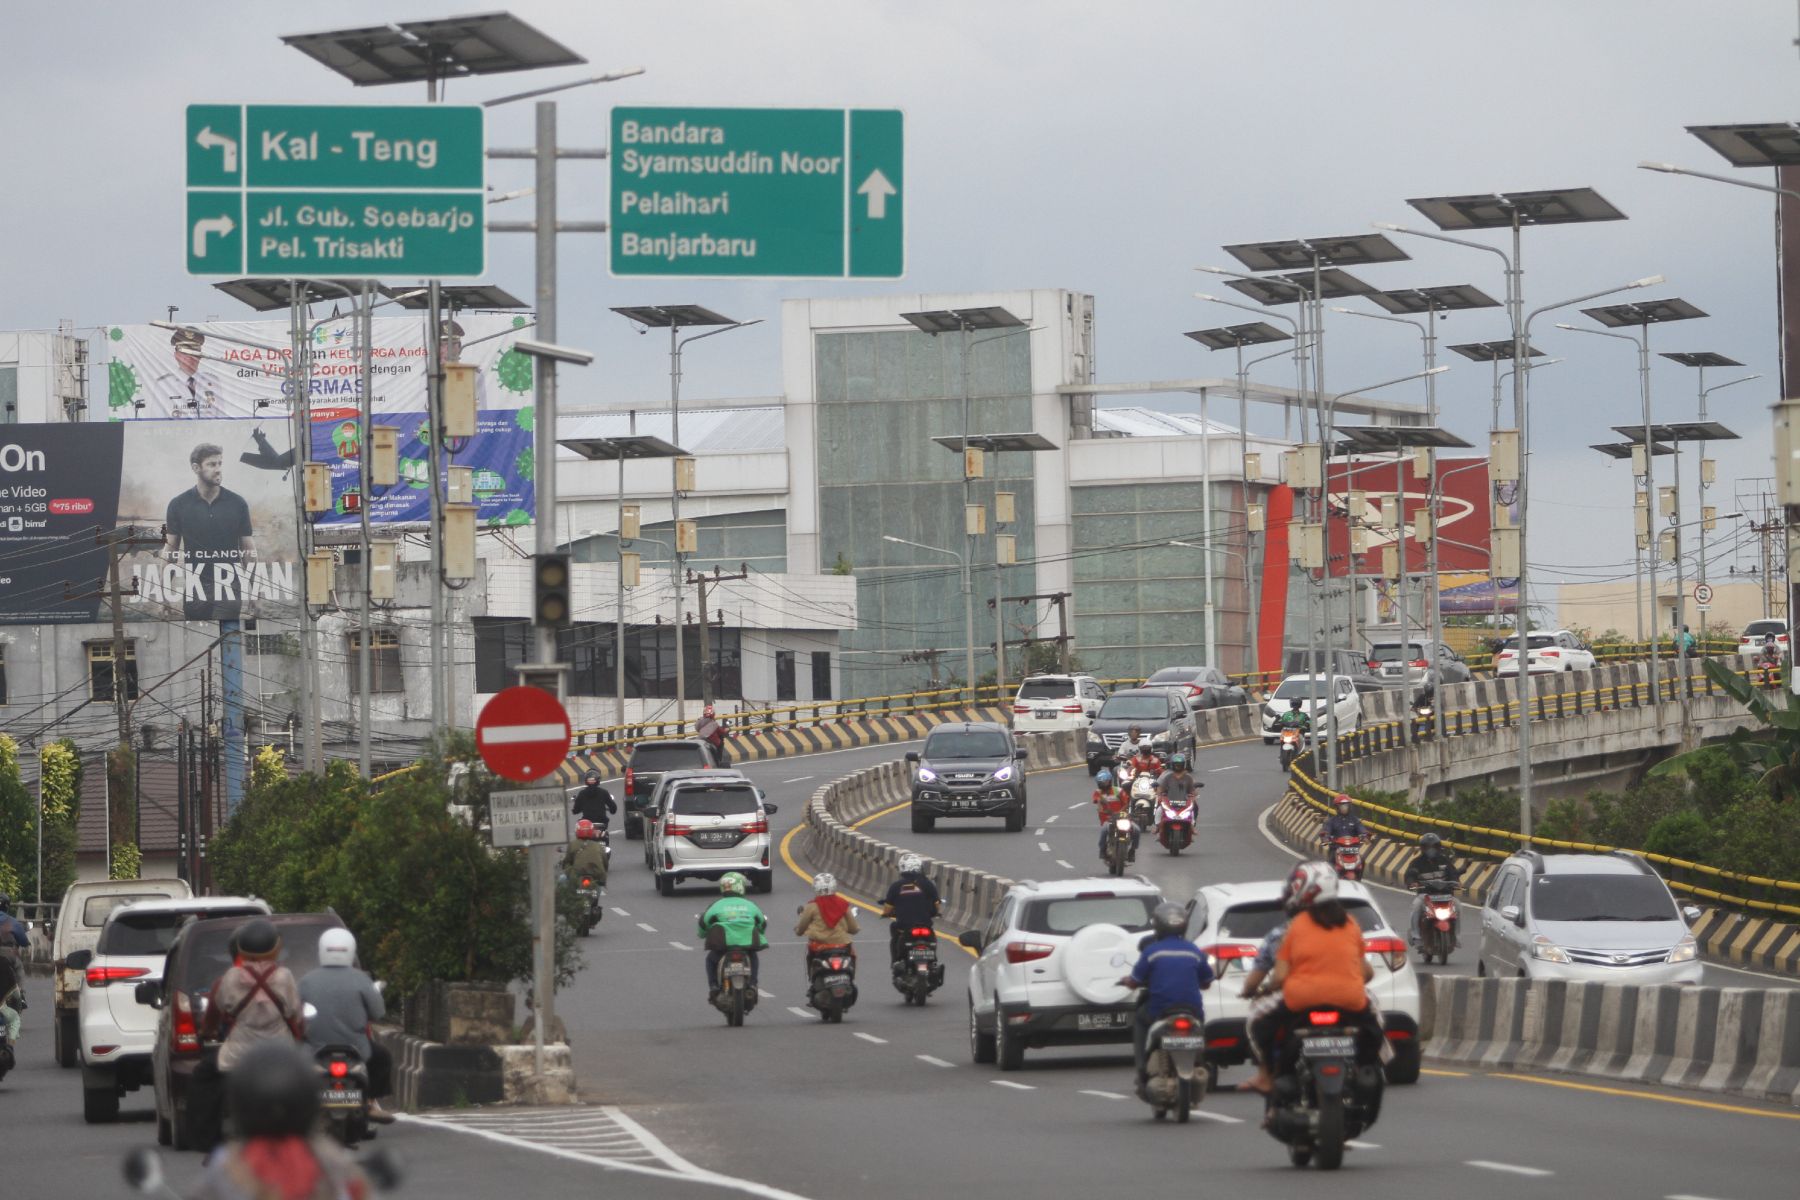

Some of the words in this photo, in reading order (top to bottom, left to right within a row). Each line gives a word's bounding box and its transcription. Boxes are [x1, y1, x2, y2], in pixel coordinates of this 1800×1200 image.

[621, 120, 724, 145] Bandara
[262, 131, 318, 161] Kal
[352, 131, 438, 169] Teng
[622, 149, 773, 178] Syamsuddin
[780, 152, 841, 174] Noor
[621, 191, 729, 215] Pelaihari
[260, 206, 289, 227] Jl.
[297, 206, 355, 227] Gub.
[363, 206, 474, 233] Soebarjo
[261, 237, 306, 258] Pel.
[313, 237, 404, 259] Trisakti
[621, 233, 756, 261] Banjarbaru
[330, 347, 395, 360] KELURGA
[399, 346, 428, 358] Anda
[237, 368, 259, 378] dari
[370, 364, 411, 376] dengan
[281, 378, 366, 396] GRMAS
[11, 486, 47, 498] Video
[25, 503, 47, 513] 5GB
[165, 551, 191, 559] TOM
[195, 549, 259, 559] CLANCY'S
[129, 562, 207, 603] JACK
[213, 561, 293, 601] RYAN
[493, 811, 529, 826] TRAILER
[514, 826, 545, 841] BAJAJ
[1079, 1014, 1091, 1025] DA
